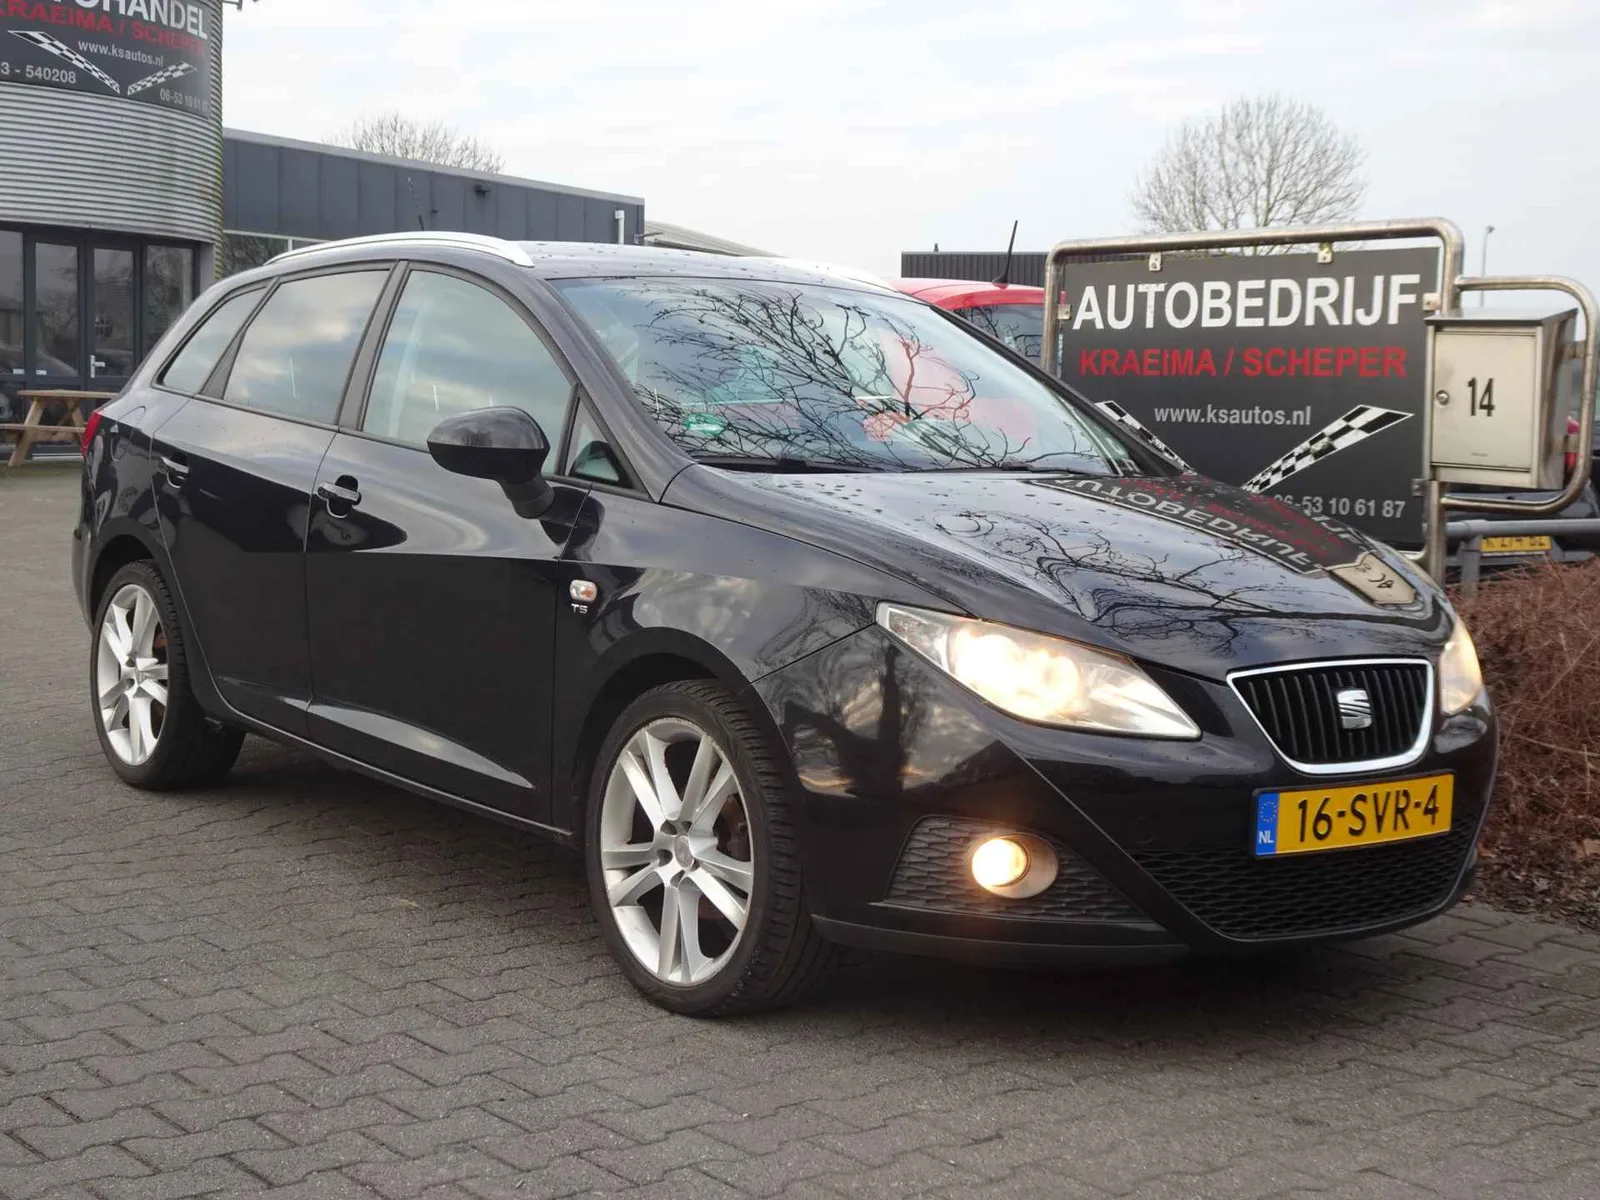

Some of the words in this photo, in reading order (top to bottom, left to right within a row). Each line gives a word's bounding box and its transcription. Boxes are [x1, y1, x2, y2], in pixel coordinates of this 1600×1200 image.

[78, 40, 164, 66] www.ksautos.nl
[25, 65, 77, 84] 540208
[1072, 273, 1420, 329] AUTOBEDRIJF
[1079, 348, 1216, 376] KRAEIMA
[1243, 346, 1408, 377] SCHEPER
[1467, 377, 1495, 417] 14
[1154, 404, 1311, 426] www.ksautos.nl
[1329, 497, 1350, 515] 10
[1354, 498, 1375, 517] 61
[1382, 500, 1406, 518] 87
[571, 603, 588, 614] TS
[1298, 784, 1439, 842] 16-SVR-4
[1258, 831, 1274, 844] NL
